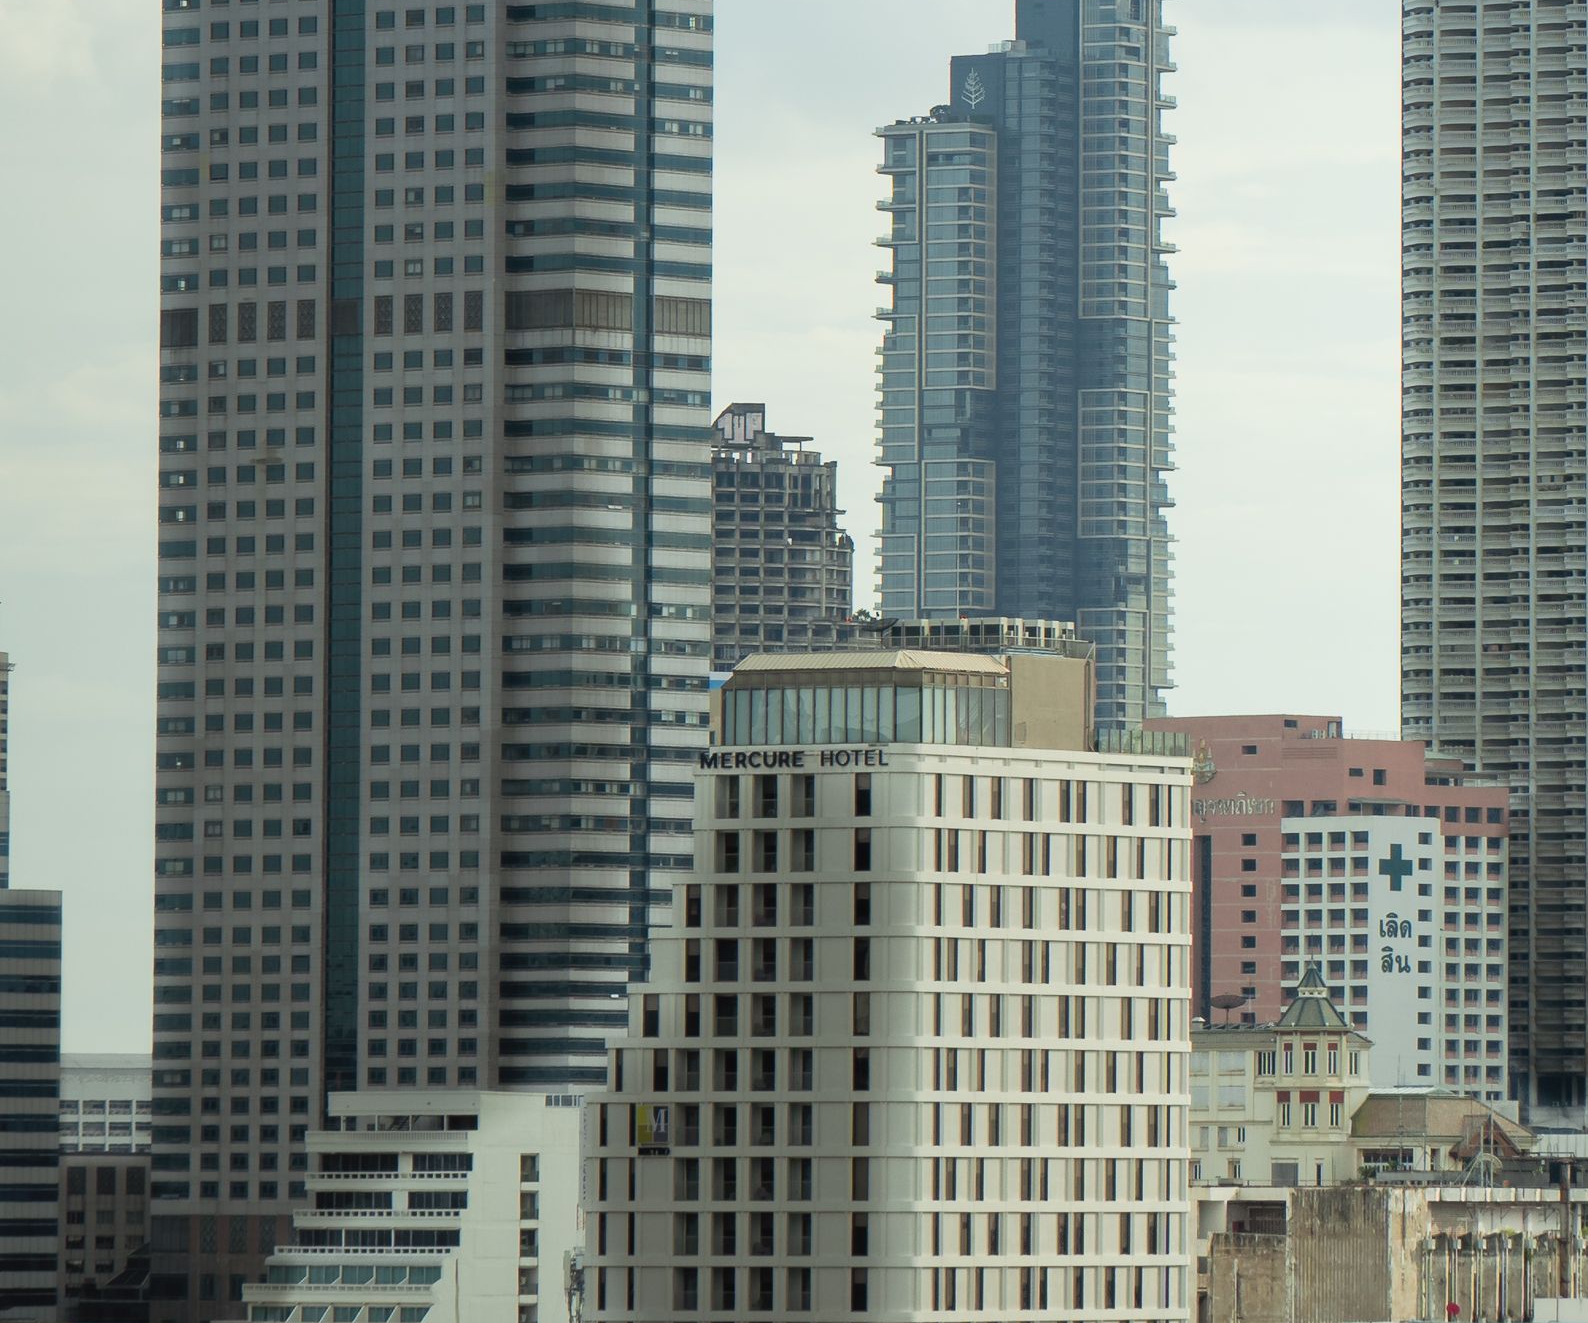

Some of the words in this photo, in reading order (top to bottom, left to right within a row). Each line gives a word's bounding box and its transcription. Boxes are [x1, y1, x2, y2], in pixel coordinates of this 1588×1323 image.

[699, 751, 805, 769] MERCURE
[820, 749, 889, 767] HOTEL
[1379, 912, 1412, 938] เลิด
[1381, 945, 1412, 973] สิน
